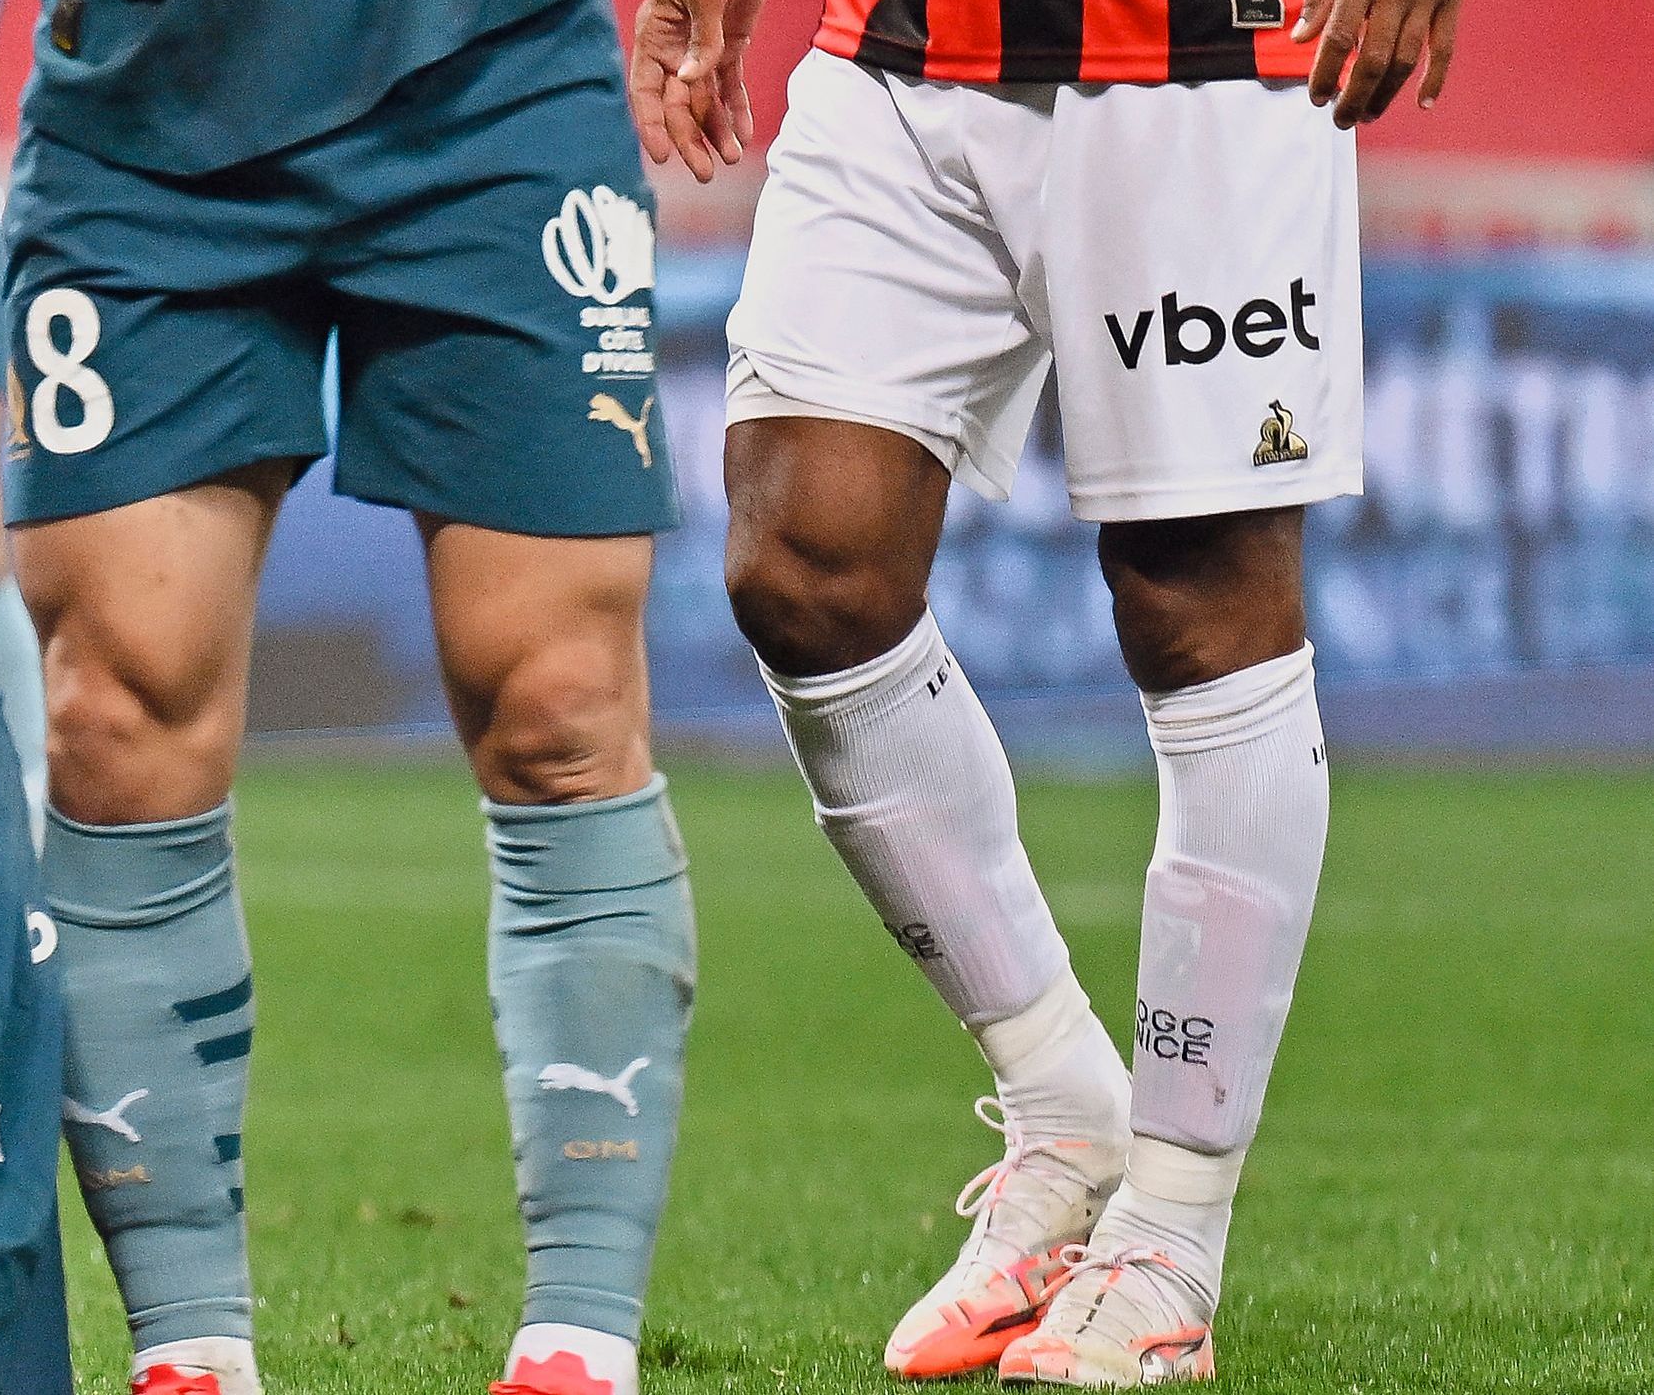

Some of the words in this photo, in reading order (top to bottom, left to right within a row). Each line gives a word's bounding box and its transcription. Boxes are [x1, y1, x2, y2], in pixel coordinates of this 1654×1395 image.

[1104, 277, 1320, 371] vbet
[25, 288, 116, 455] 8
[1136, 1020, 1210, 1068] NICE
[1138, 999, 1214, 1040] OGC
